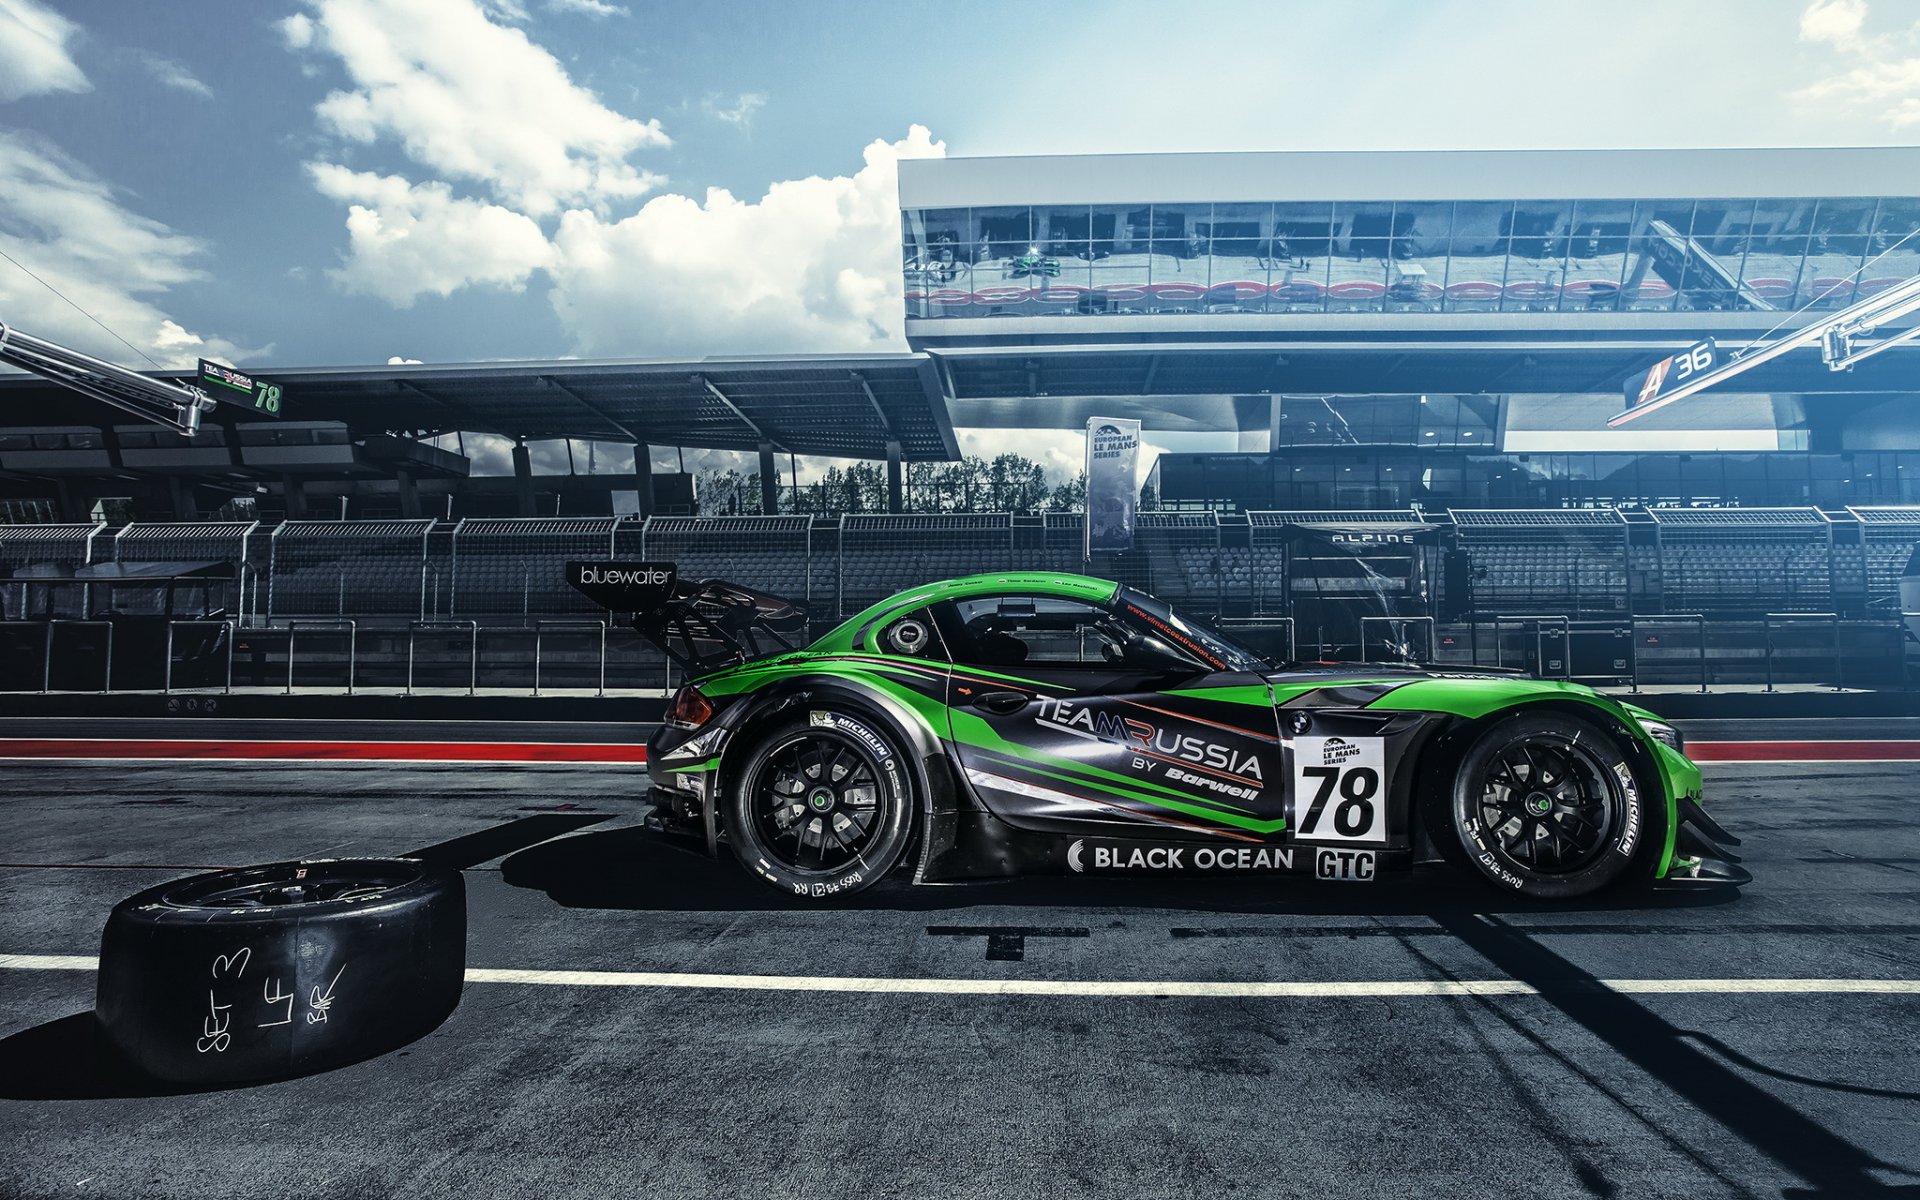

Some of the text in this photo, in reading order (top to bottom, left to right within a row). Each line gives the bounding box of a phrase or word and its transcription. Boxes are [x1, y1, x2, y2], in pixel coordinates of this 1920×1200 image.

[1674, 342, 1712, 380] 36
[255, 380, 280, 413] 78
[1093, 440, 1138, 451] LE MANS
[1094, 434, 1133, 443] EUROPEAN
[1093, 450, 1120, 459] SERIES
[1332, 534, 1414, 544] ALPINE
[580, 565, 672, 585] bluewater
[837, 717, 888, 757] MICHELIN
[1323, 743, 1356, 753] EUROPEAN
[1335, 748, 1361, 758] MANS
[1323, 757, 1347, 766] SERIES
[1131, 756, 1259, 801] BY Barwell
[1298, 766, 1379, 838] 78
[1620, 788, 1639, 855] MICHELIN
[1095, 847, 1294, 869] BLACK OCEAN
[1317, 850, 1374, 880] GTC
[792, 882, 808, 895] RR
[839, 871, 863, 889] RUSS
[1501, 870, 1523, 889] RUSS
[196, 947, 251, 1053] SET 3
[257, 976, 294, 1028] LF
